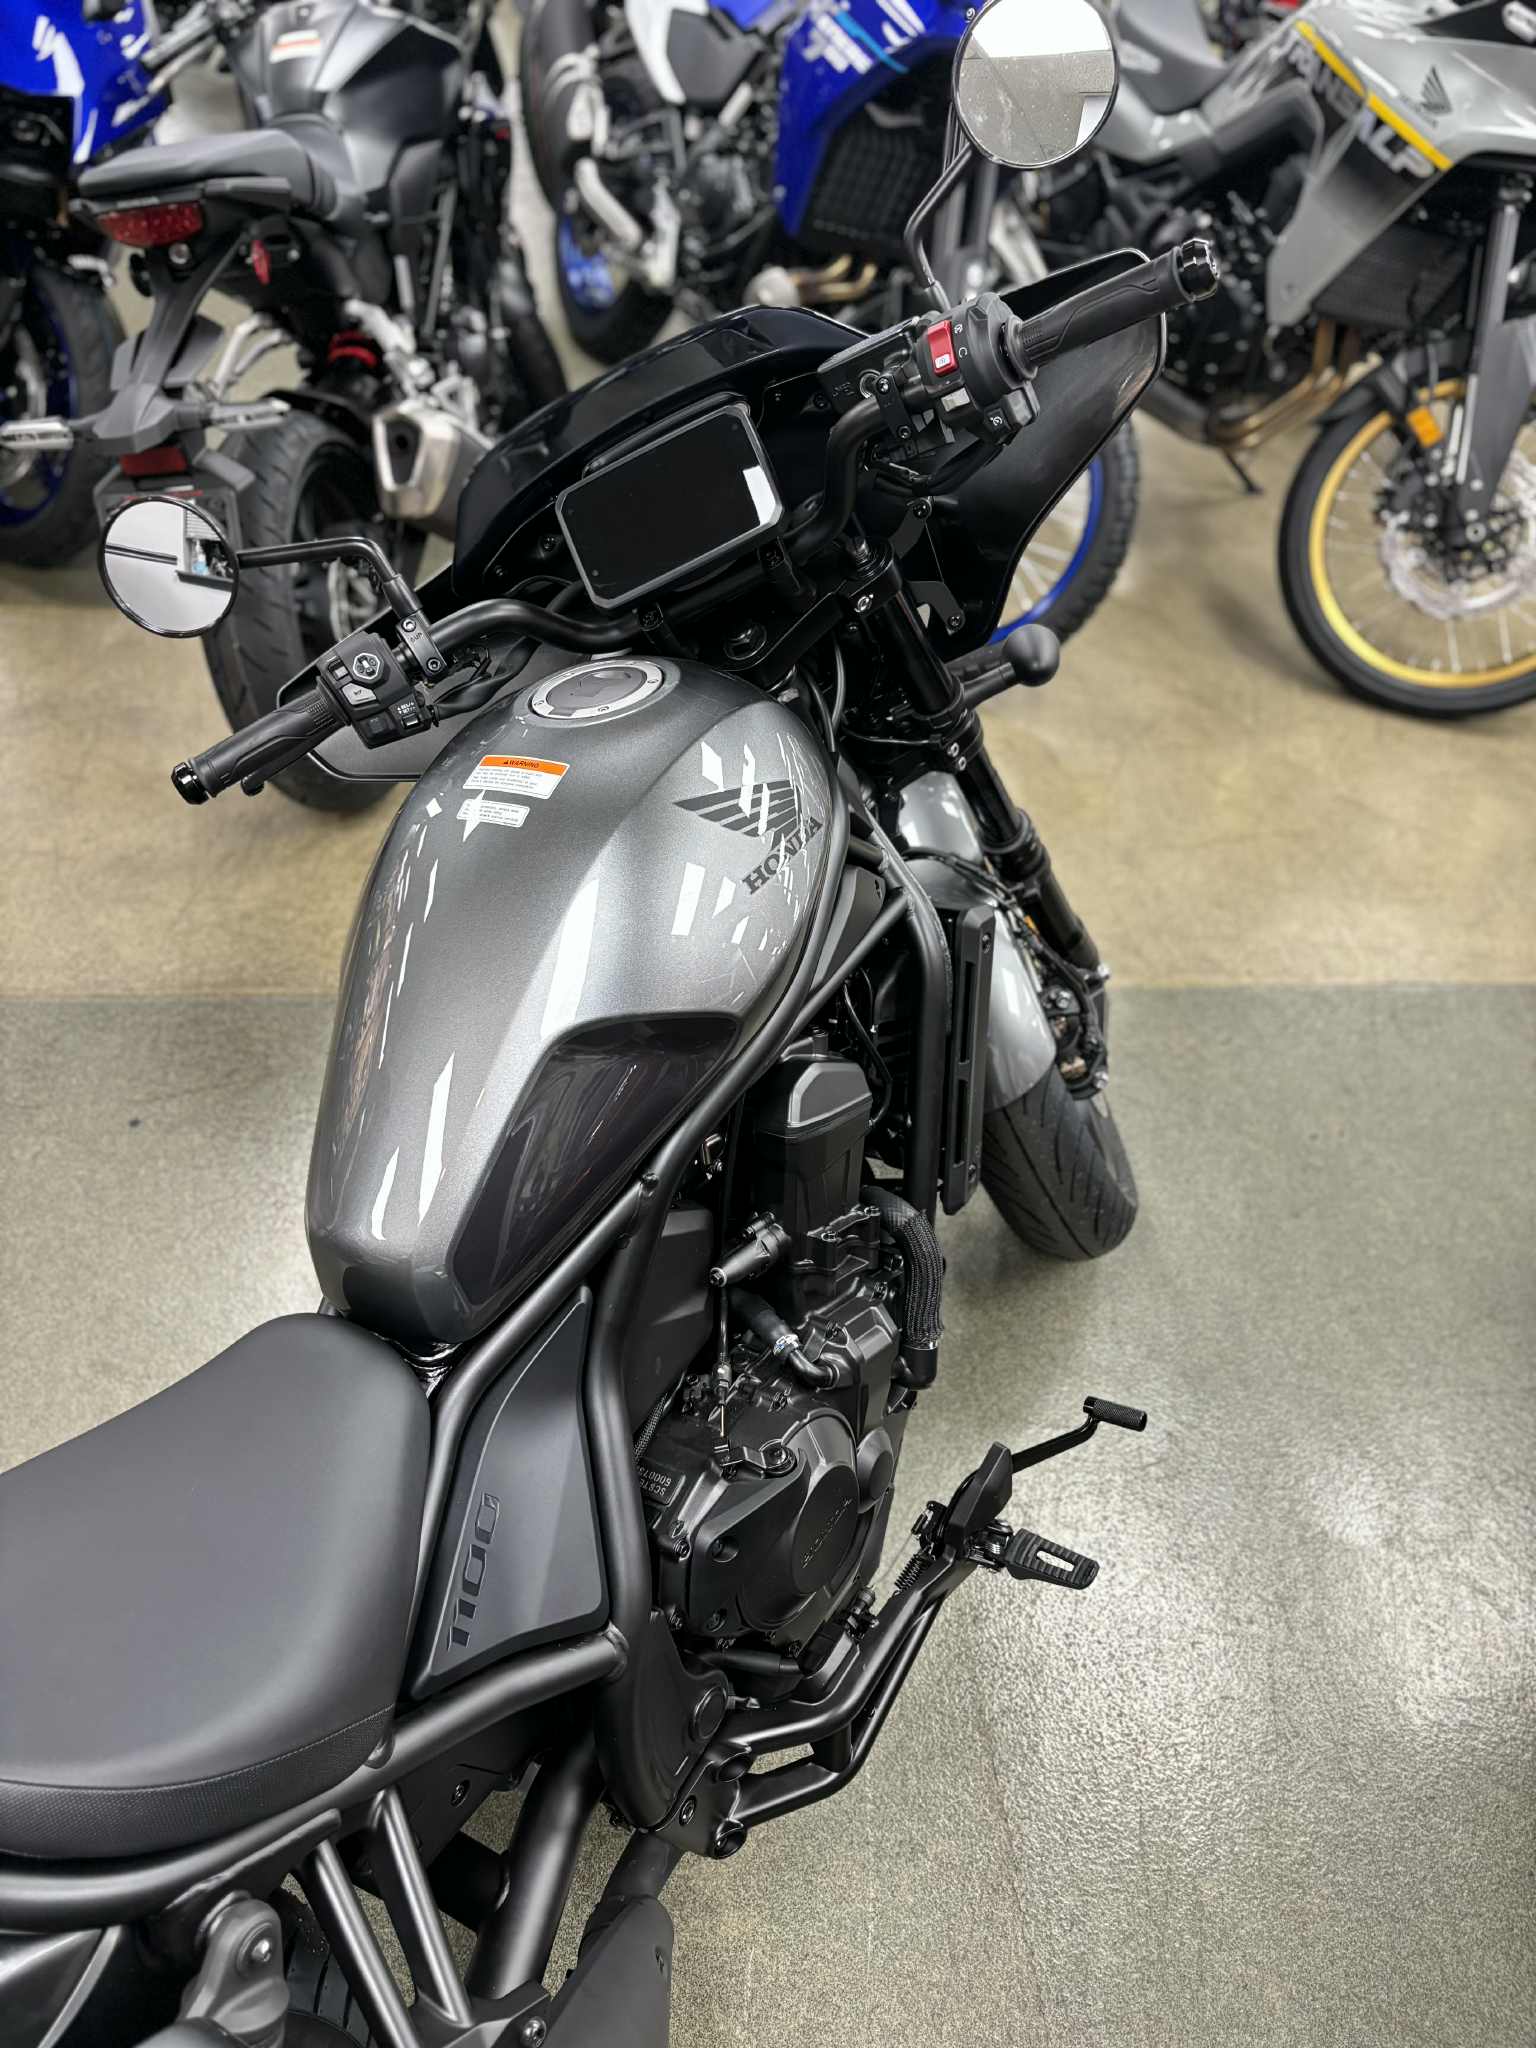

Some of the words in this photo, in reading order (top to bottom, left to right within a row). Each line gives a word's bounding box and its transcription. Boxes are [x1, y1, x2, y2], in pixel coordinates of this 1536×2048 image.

[509, 759, 540, 769] WARNING
[742, 816, 824, 896] HONDA
[447, 1491, 501, 1652] 1100
